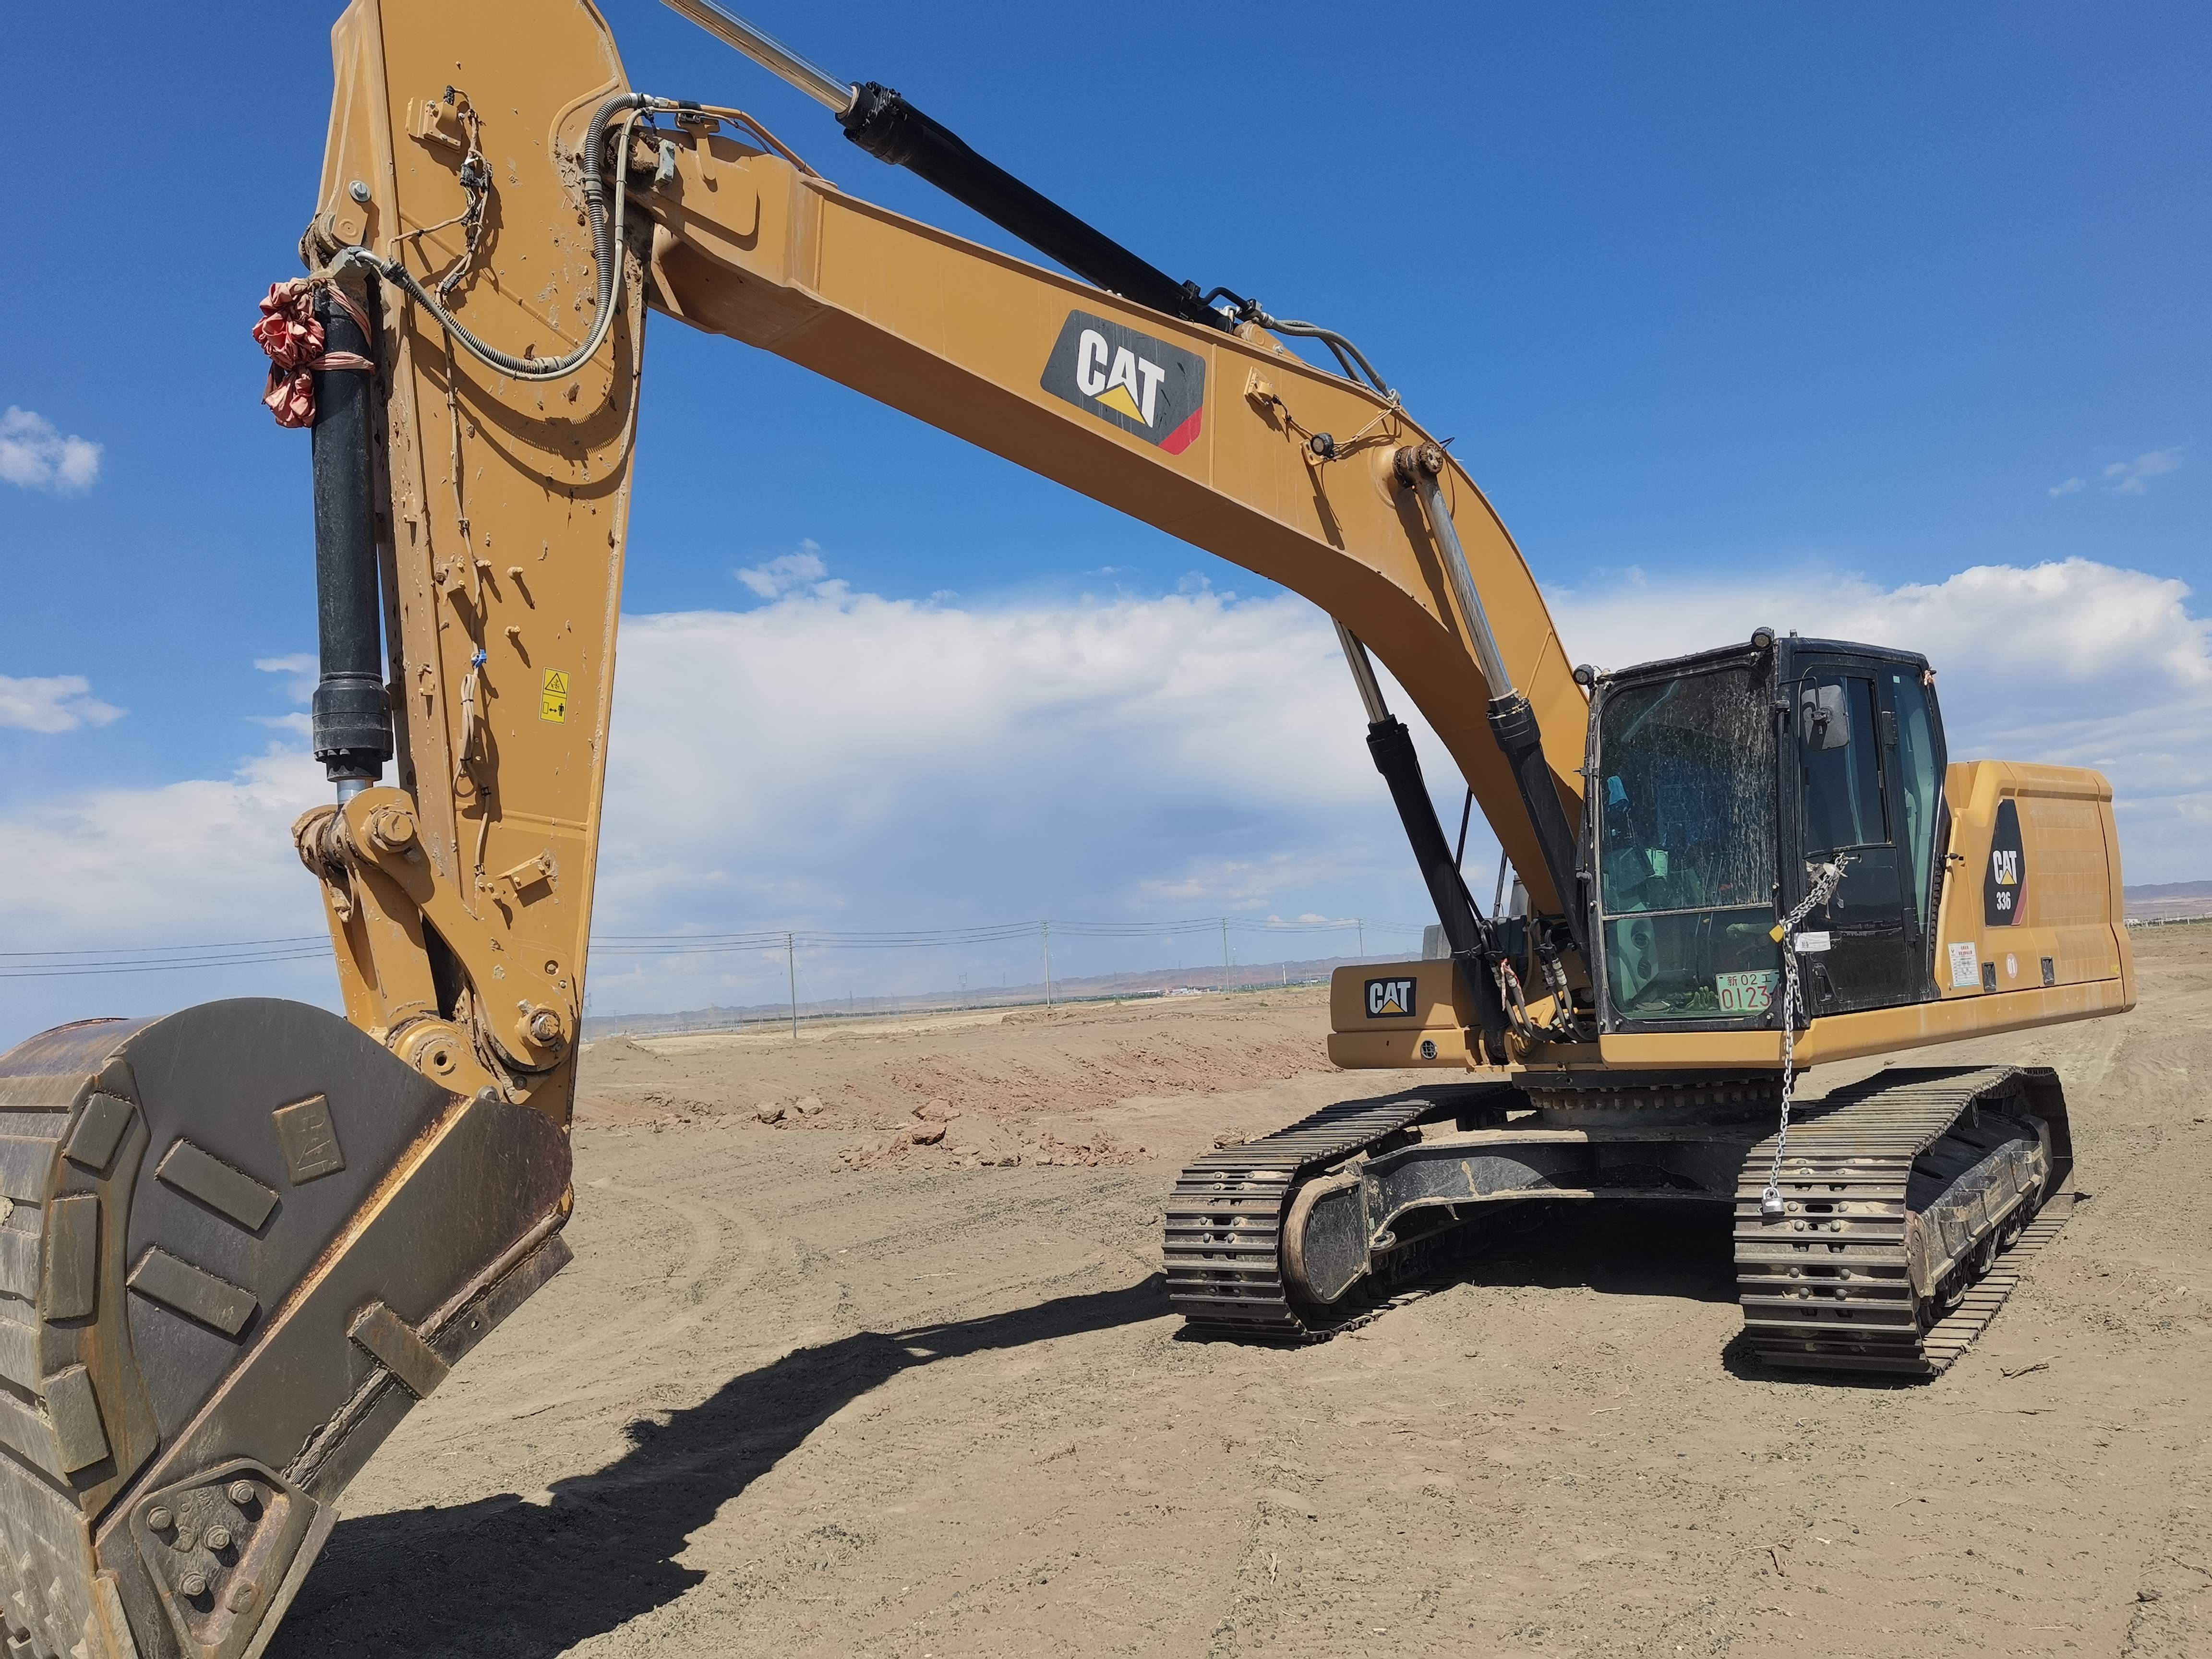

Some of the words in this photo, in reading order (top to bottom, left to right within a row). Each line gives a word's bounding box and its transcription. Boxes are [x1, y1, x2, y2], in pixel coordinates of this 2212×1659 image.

[1076, 329, 1166, 428] CAT
[1993, 850, 2017, 885] CAT
[1996, 891, 2011, 910] 336
[1370, 981, 1411, 1014] CAT
[1721, 986, 1770, 1009] 0123
